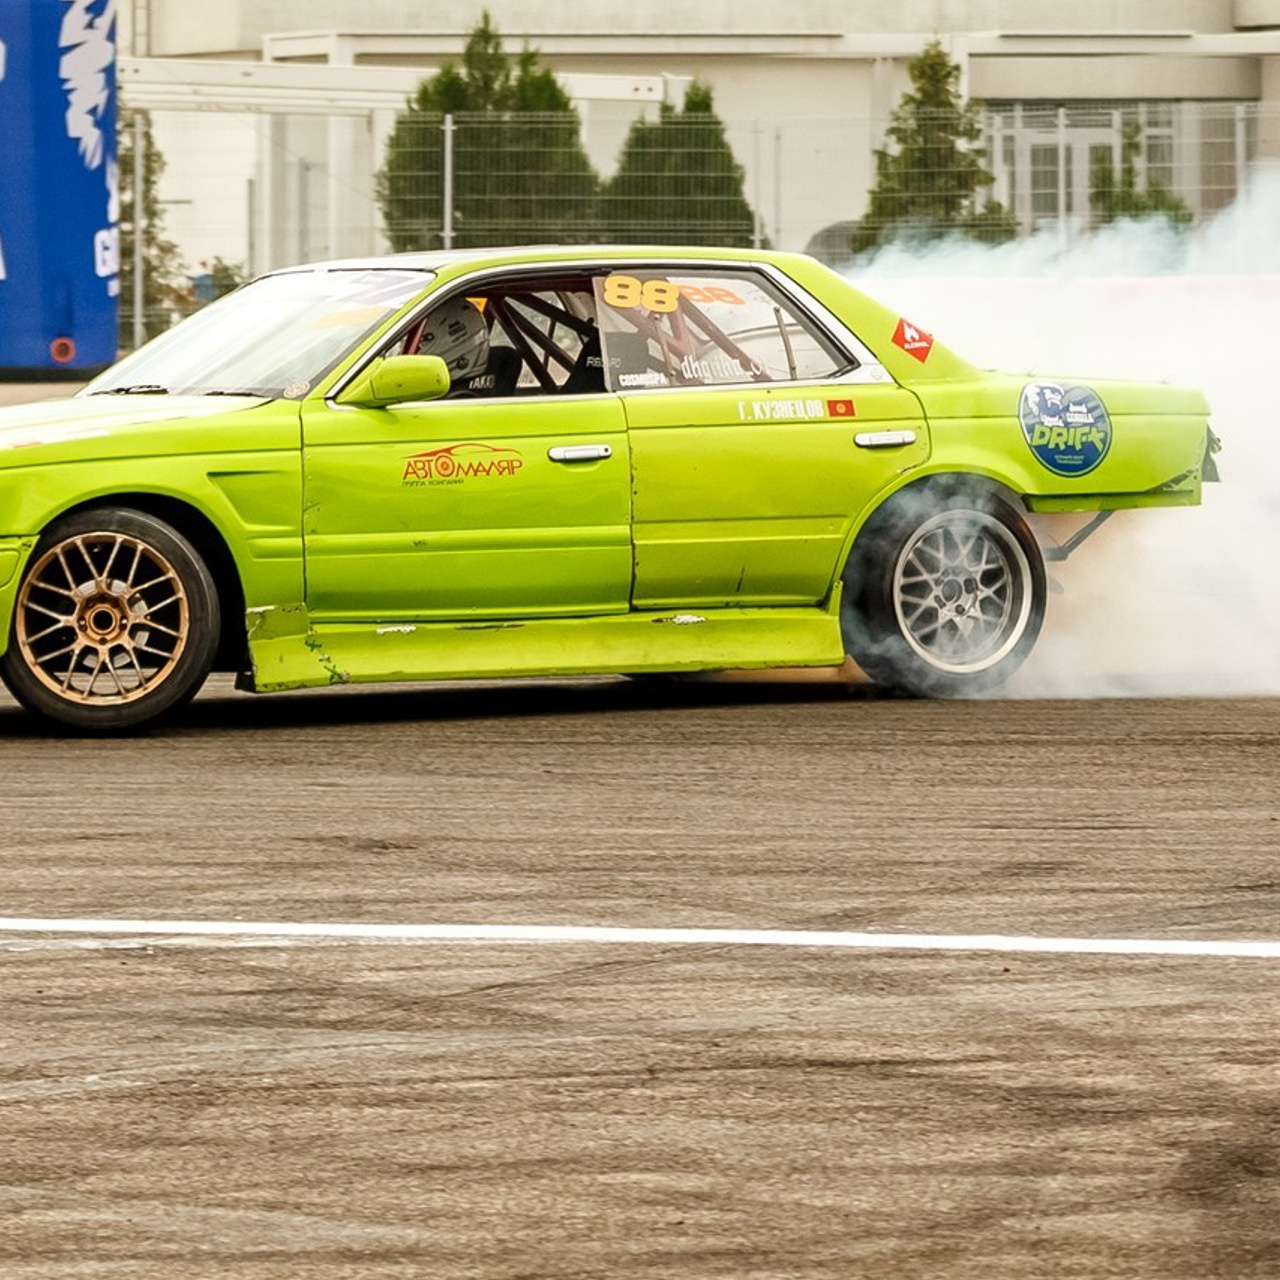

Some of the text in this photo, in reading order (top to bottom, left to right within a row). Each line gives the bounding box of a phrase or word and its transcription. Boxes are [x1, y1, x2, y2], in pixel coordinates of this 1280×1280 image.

[603, 275, 680, 313] 88
[752, 399, 825, 420] КУЗНЕЦОВ
[1031, 425, 1105, 453] DRIFT
